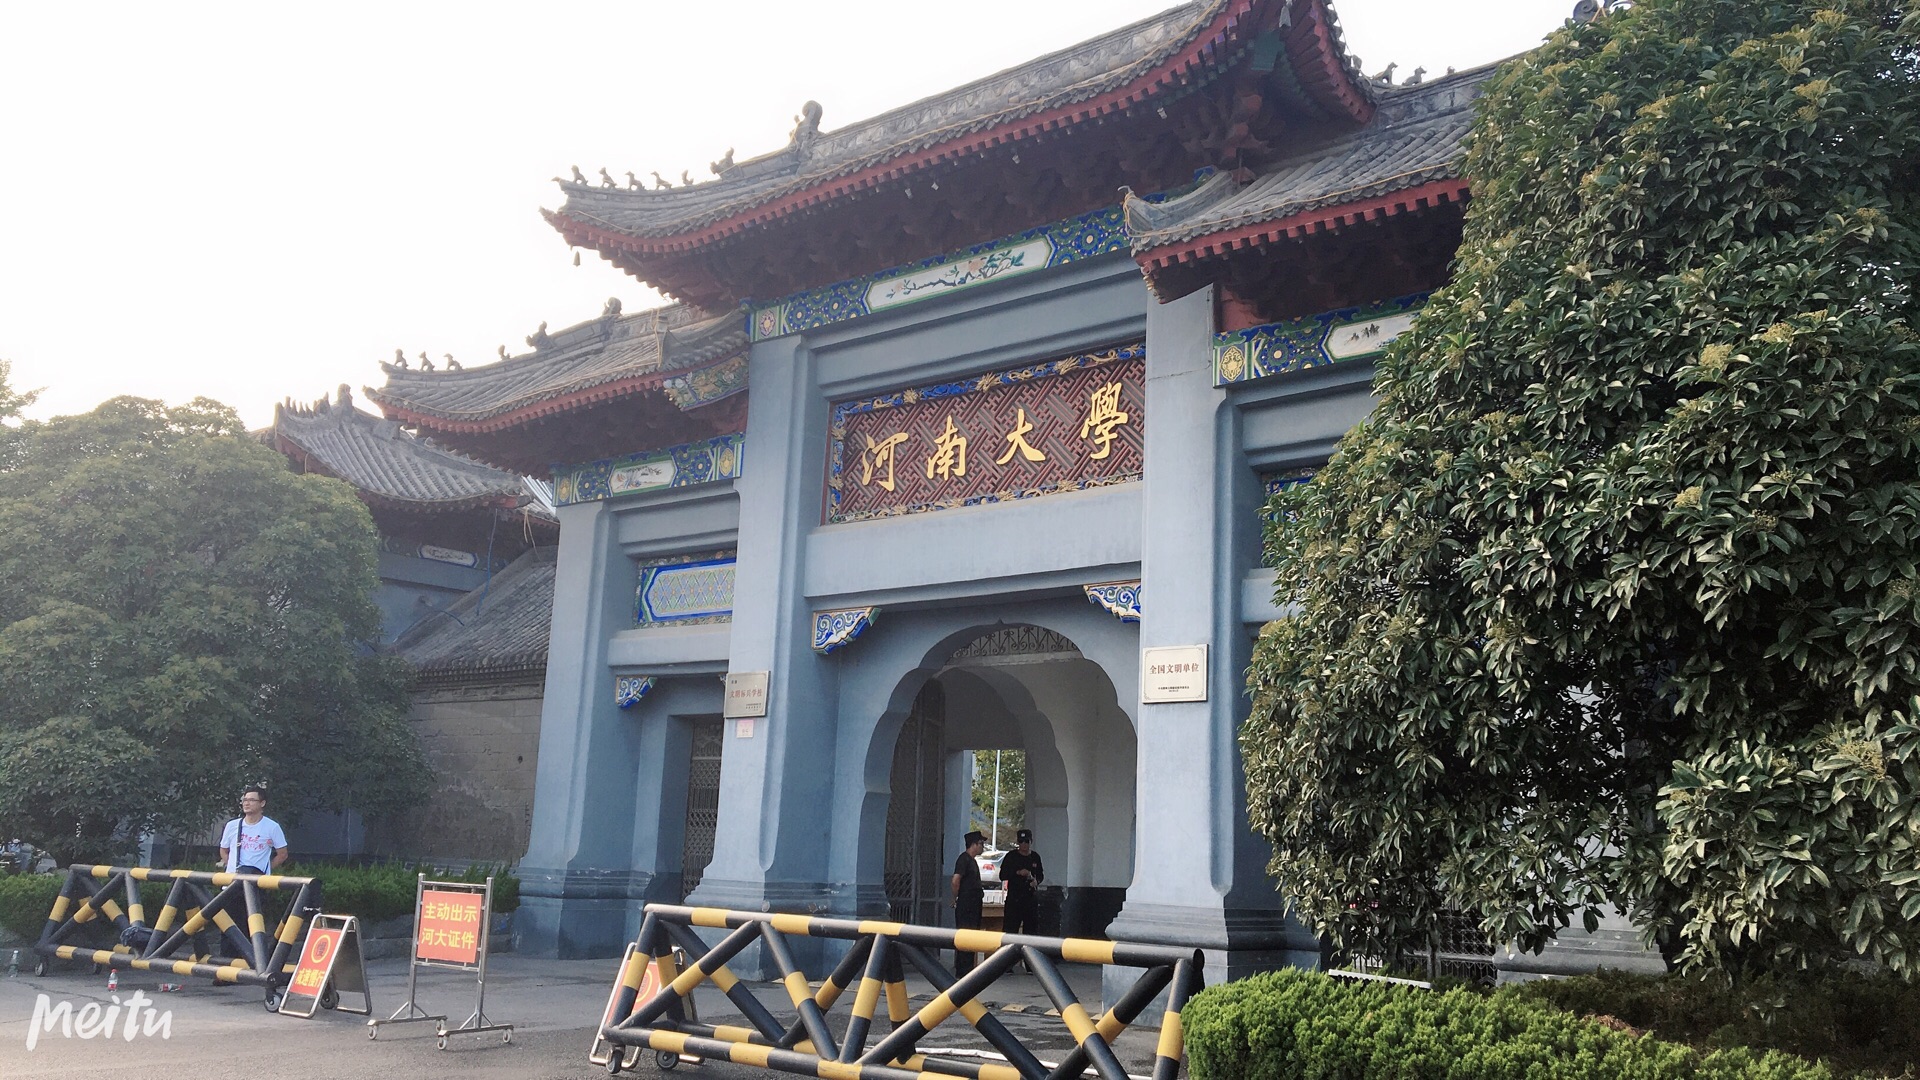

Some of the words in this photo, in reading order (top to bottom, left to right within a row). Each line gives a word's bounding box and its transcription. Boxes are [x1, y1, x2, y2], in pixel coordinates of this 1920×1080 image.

[861, 381, 1129, 492] 河南大學
[1149, 662, 1200, 675] 全国文明单位
[423, 902, 478, 923] 主动出示
[421, 927, 475, 950] 河大证件
[295, 967, 326, 988] 减速慢行
